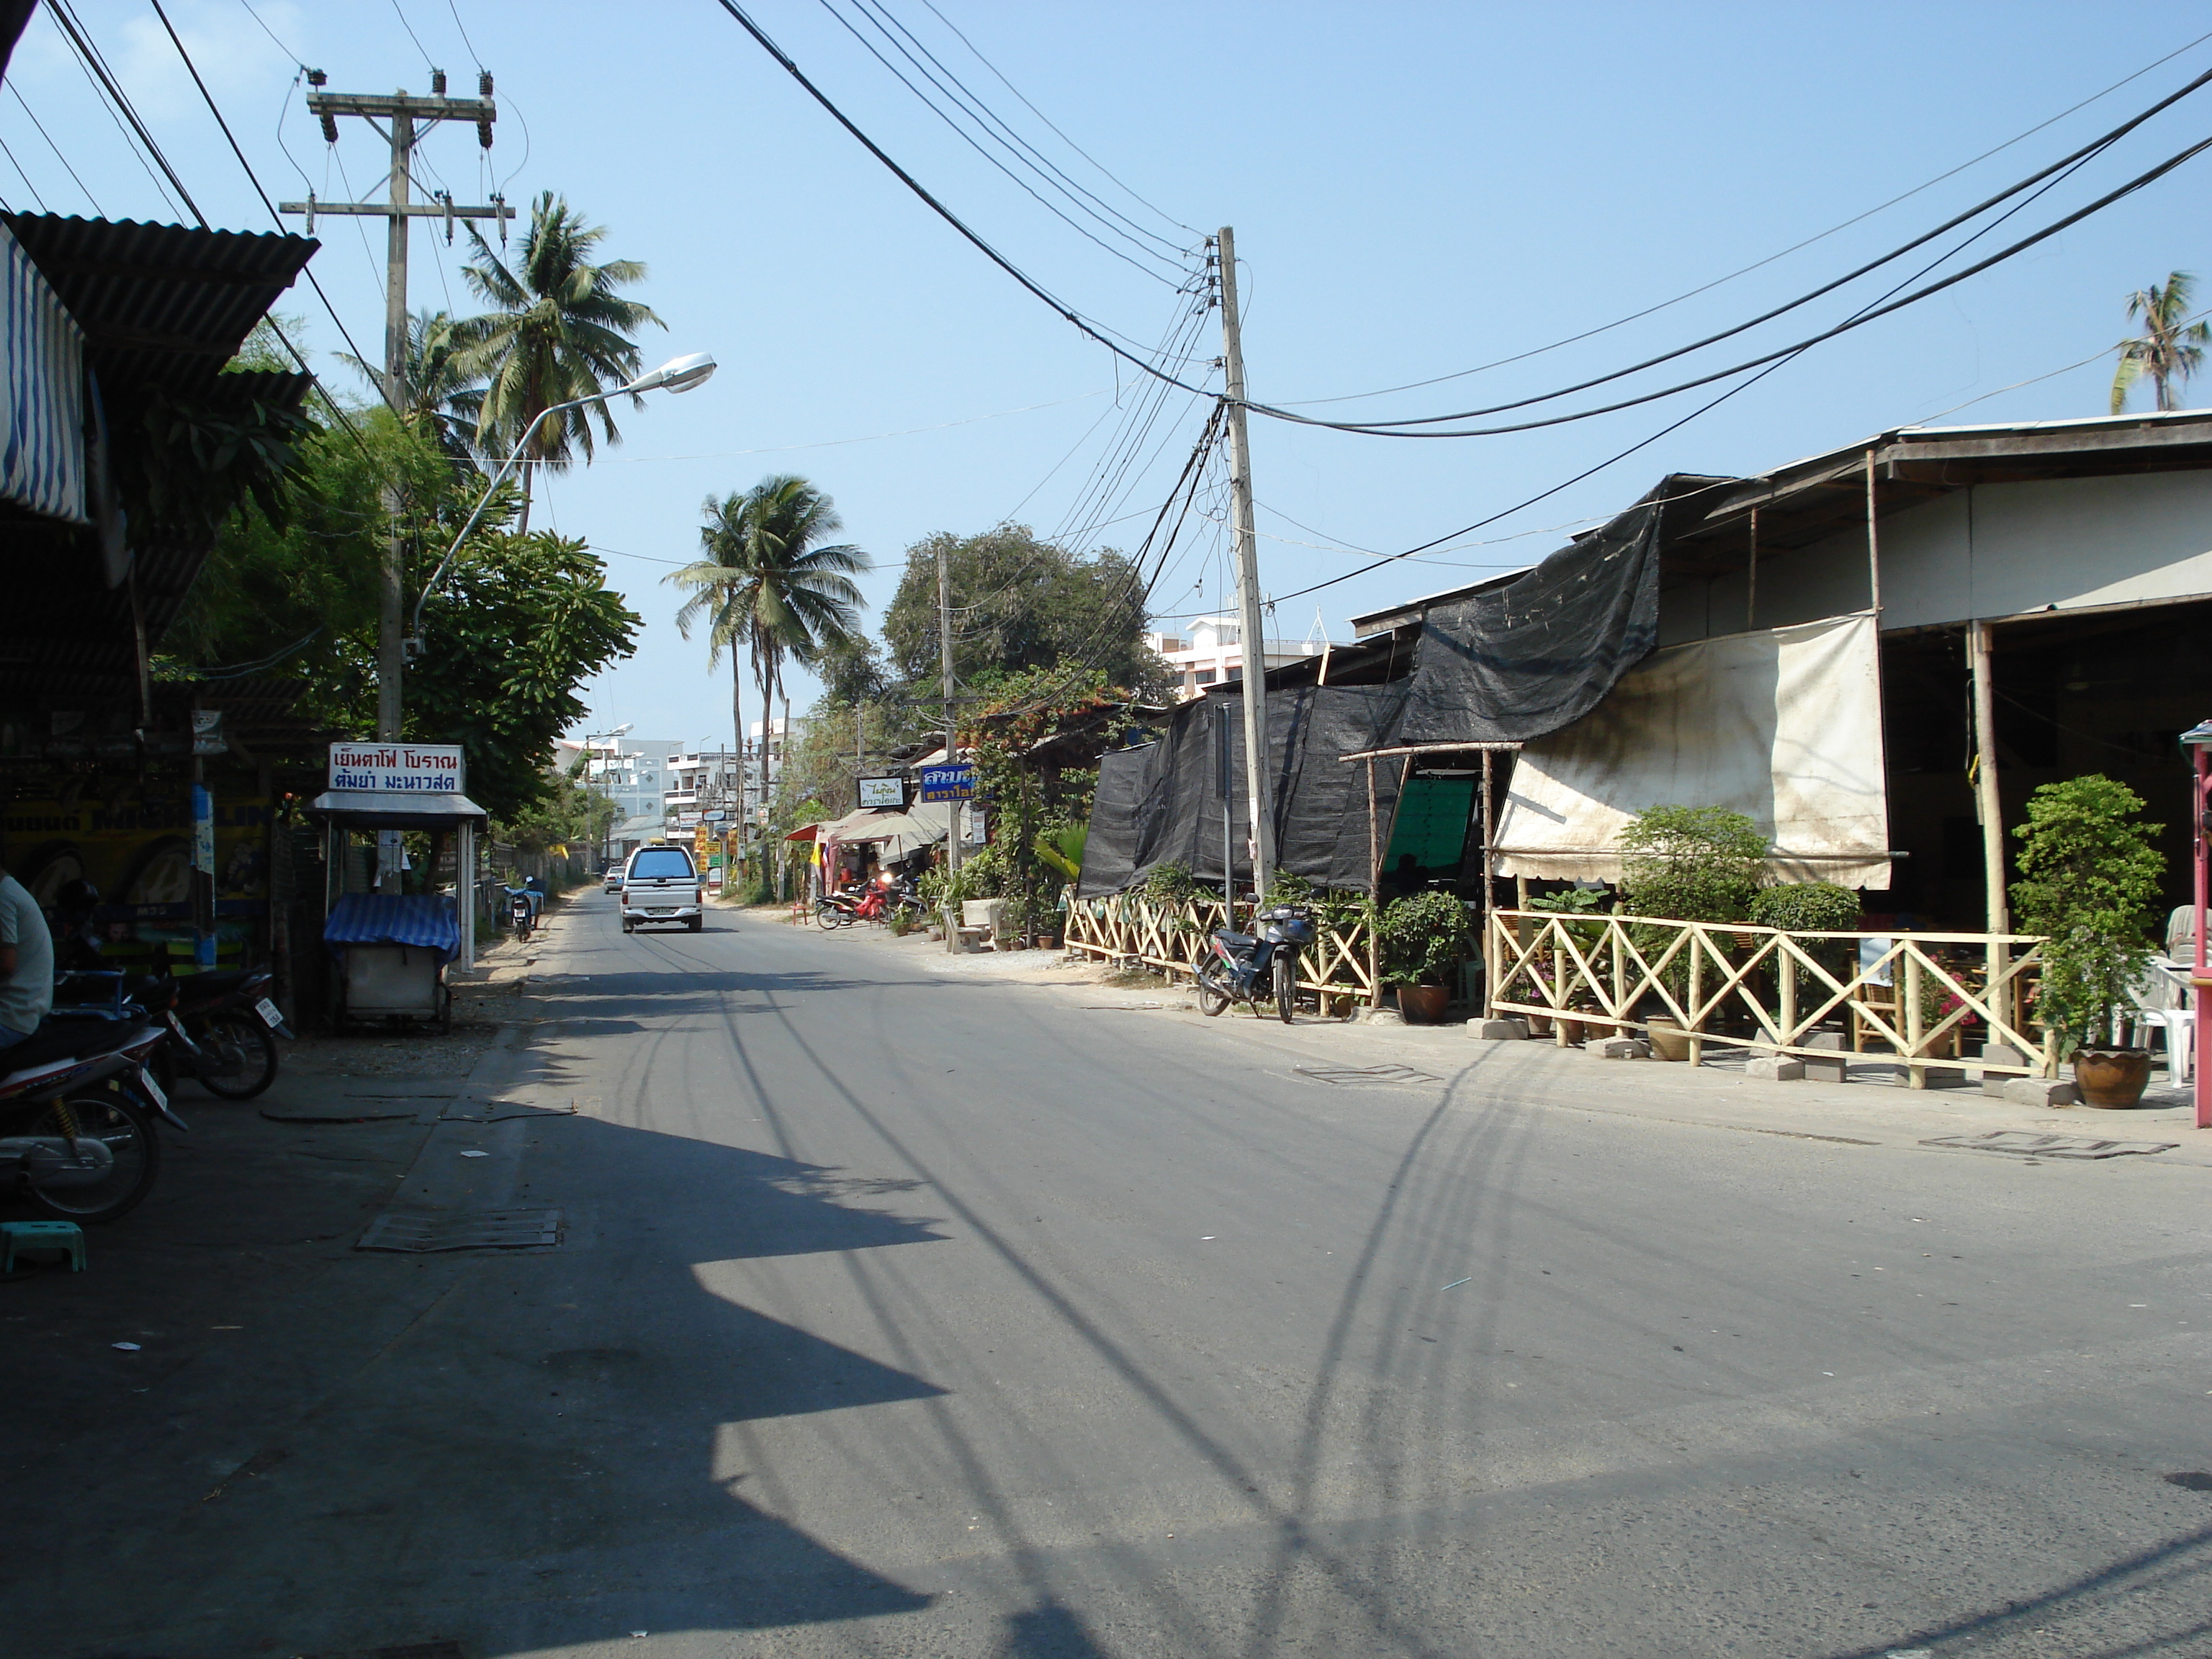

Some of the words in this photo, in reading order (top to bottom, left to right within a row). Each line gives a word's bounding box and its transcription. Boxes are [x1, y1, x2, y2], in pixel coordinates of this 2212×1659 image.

[334, 747, 397, 768] เย็นตาโฟ
[403, 750, 458, 769] โบราณ
[334, 768, 377, 788] ต้มยำ
[385, 773, 456, 791] มะนาวสด
[91, 805, 276, 830] MICHLIN
